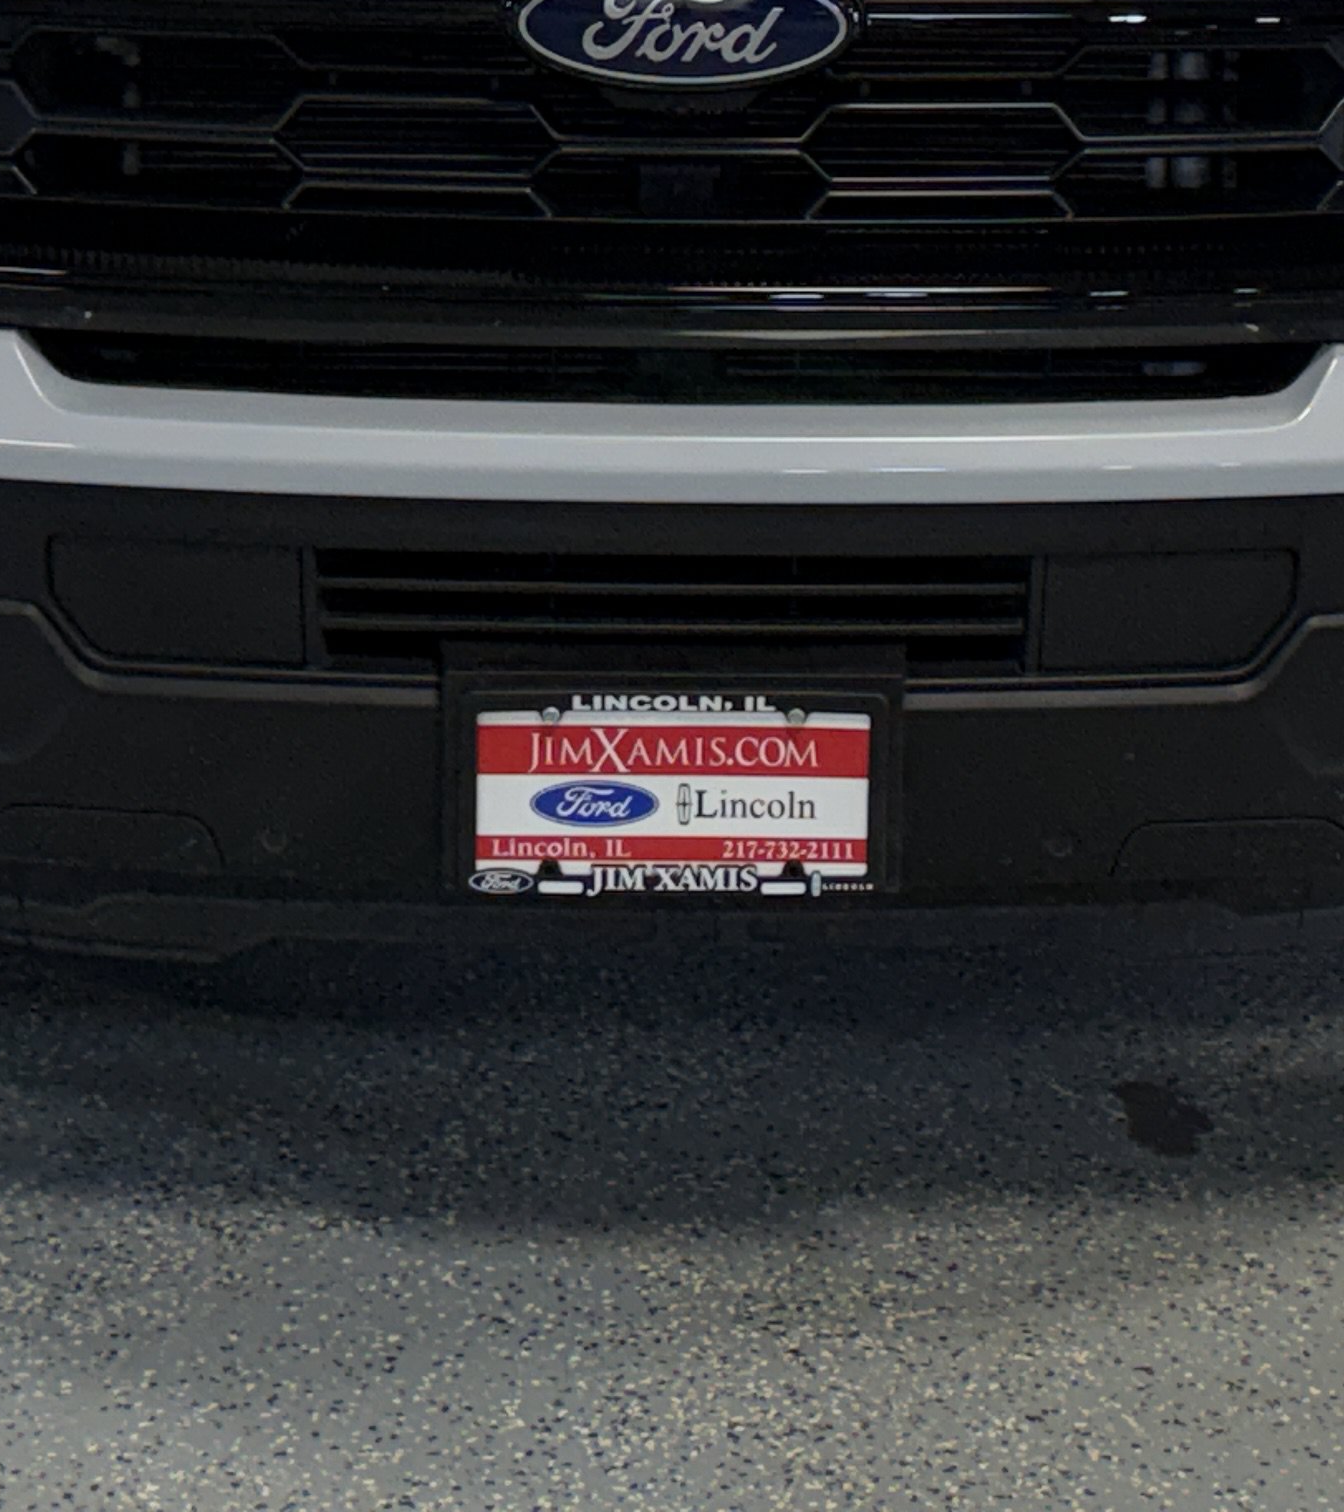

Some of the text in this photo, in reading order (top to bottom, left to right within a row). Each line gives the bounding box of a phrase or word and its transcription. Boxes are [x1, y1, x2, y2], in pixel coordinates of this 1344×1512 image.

[571, 694, 777, 713] LINCOLN, IL
[555, 785, 816, 820] Ford Lincoln
[605, 839, 632, 858] IL
[722, 839, 855, 860] 217-732-2111
[586, 865, 758, 897] JIM XAMIS
